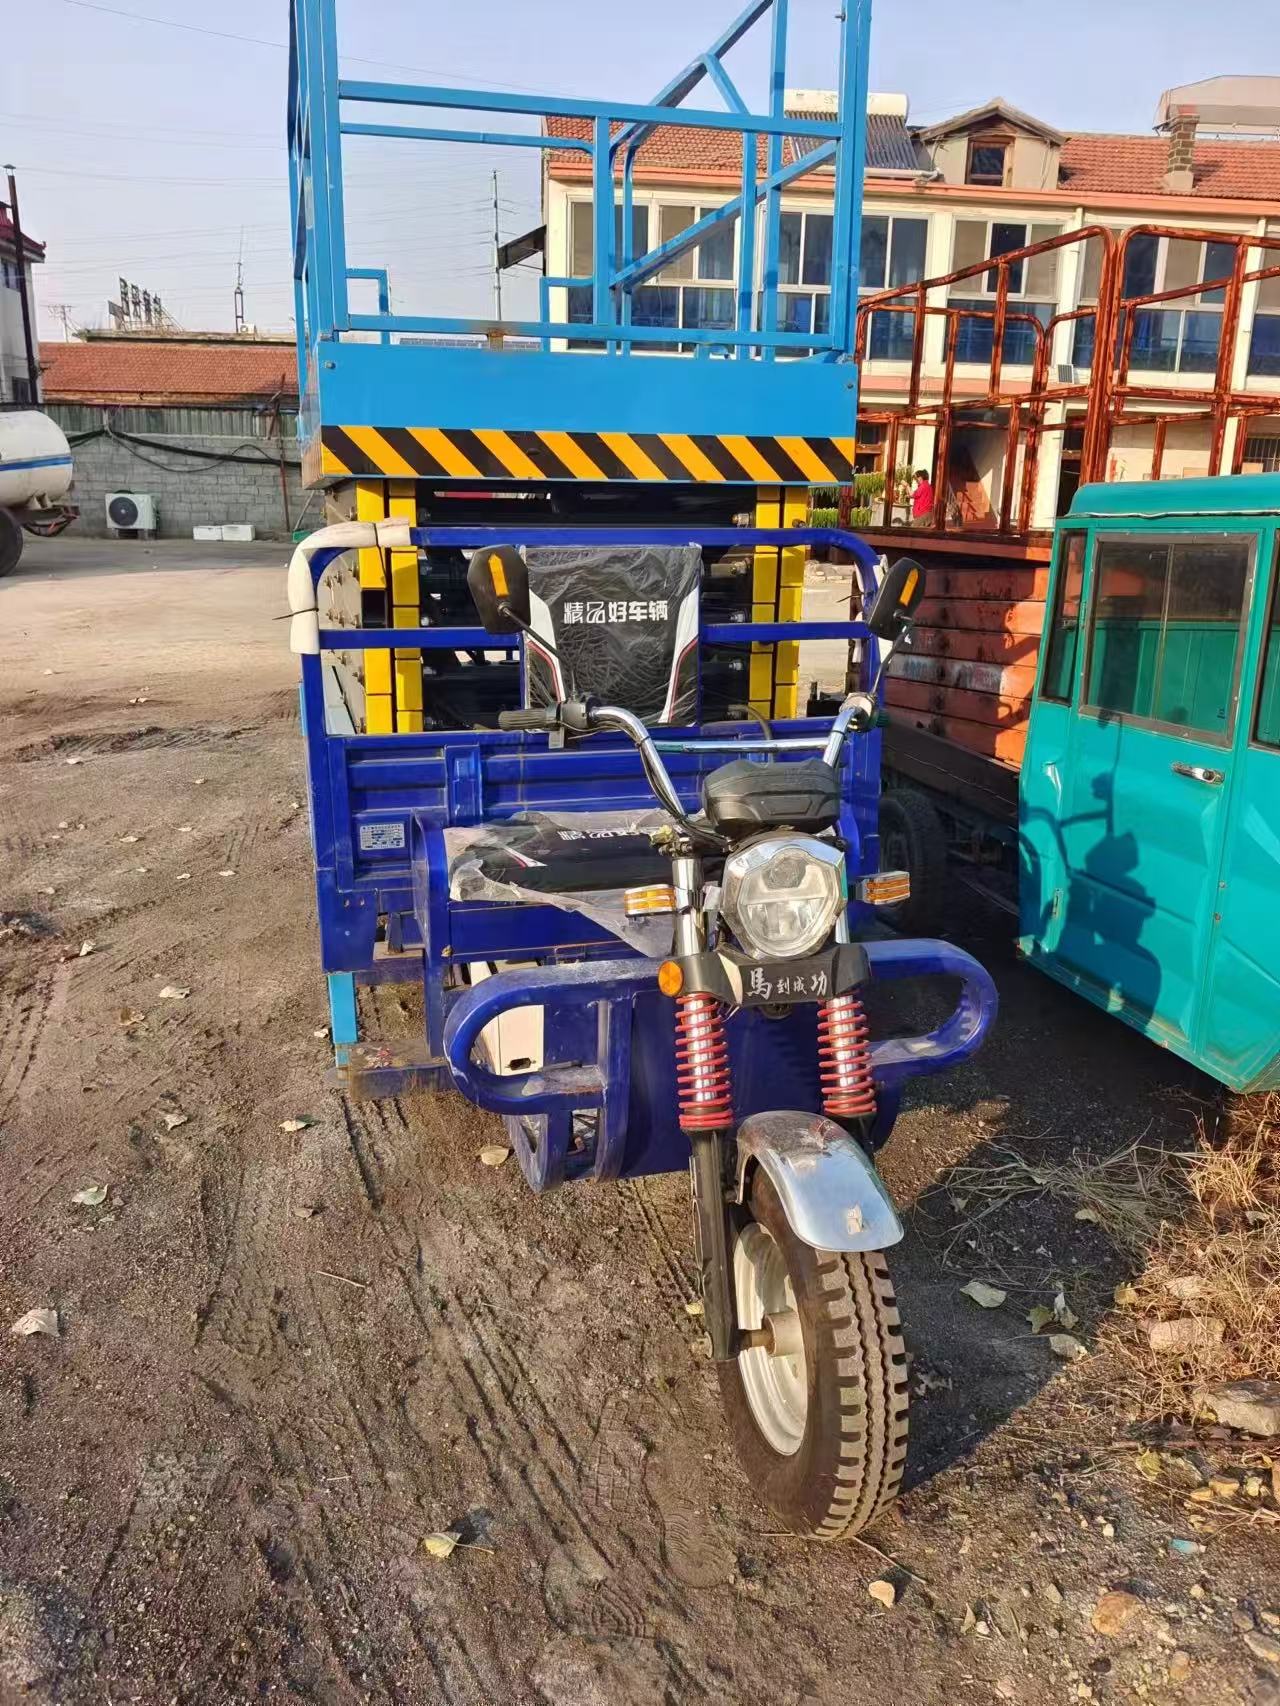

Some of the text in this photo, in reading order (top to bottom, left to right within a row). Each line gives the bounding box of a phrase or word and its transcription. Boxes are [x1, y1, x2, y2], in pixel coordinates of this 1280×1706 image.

[563, 600, 669, 624] 精品好车辆
